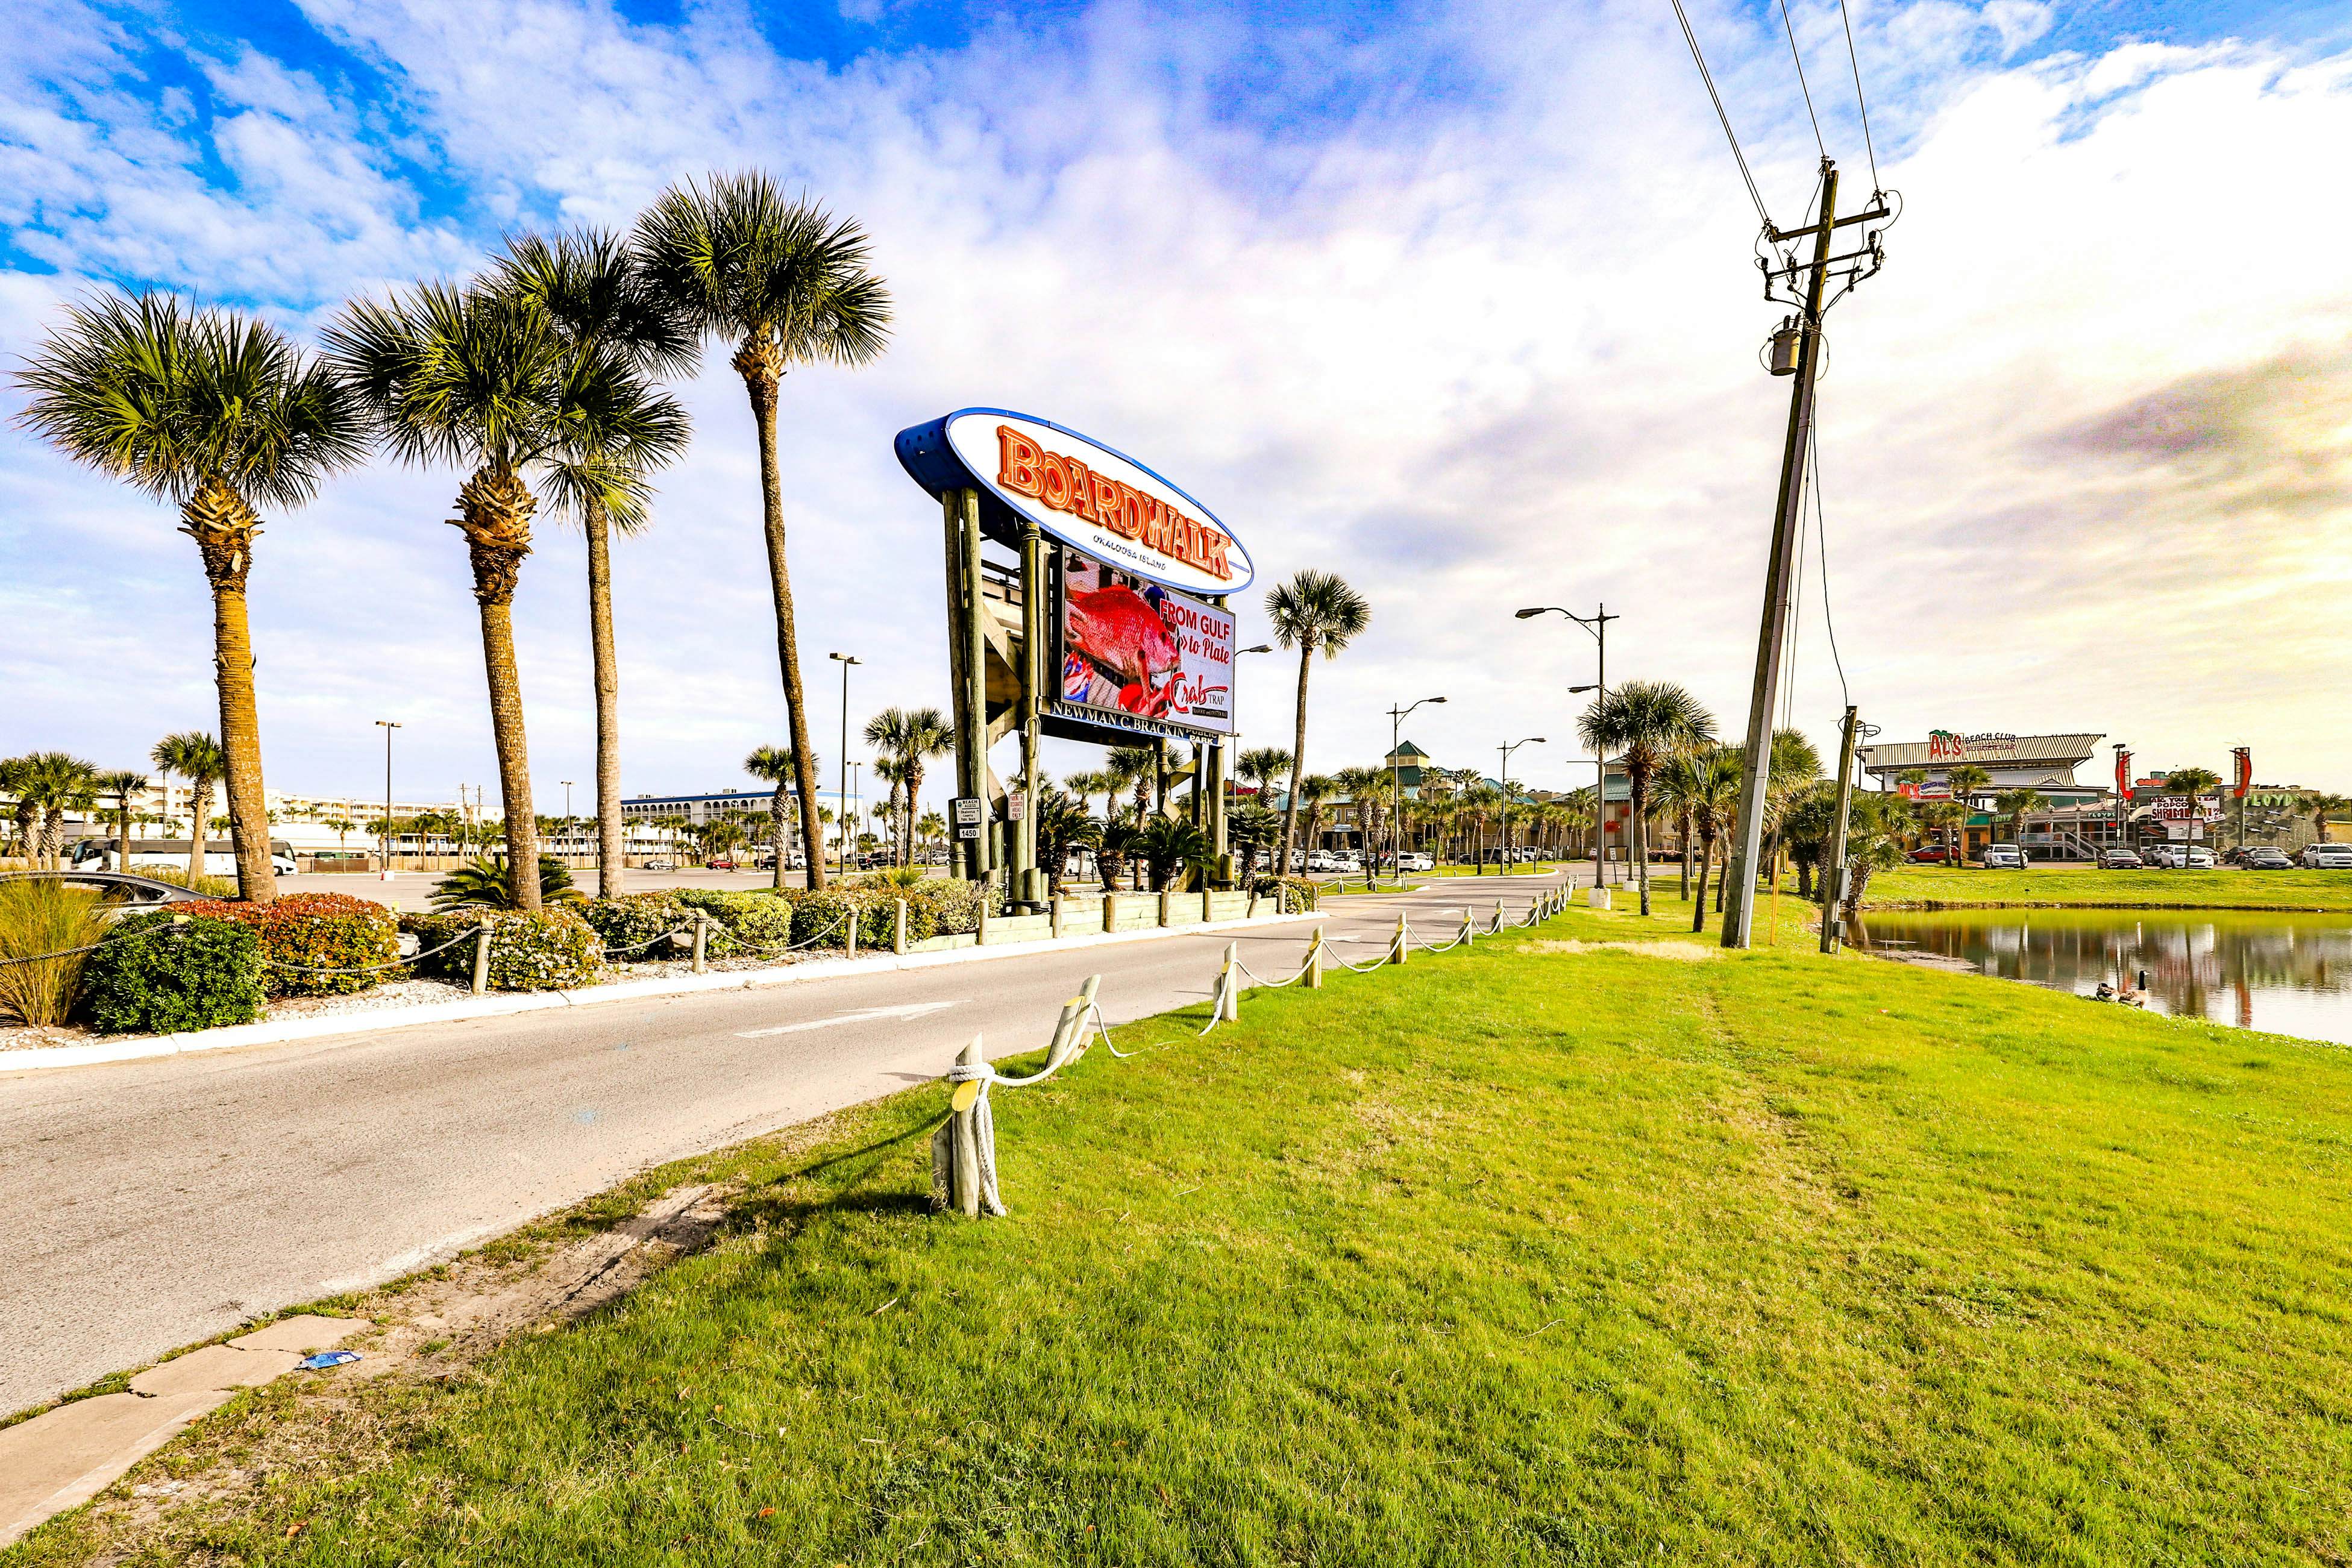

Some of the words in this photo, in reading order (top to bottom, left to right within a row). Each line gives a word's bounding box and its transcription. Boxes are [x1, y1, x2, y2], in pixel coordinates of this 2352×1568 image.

[997, 425, 1232, 580] BOARDWALK
[1093, 535, 1137, 559] OKALOOSA
[1139, 554, 1166, 570] ISLAND
[1160, 598, 1197, 630] FROM
[1200, 614, 1230, 641] GULF
[1189, 635, 1200, 654] to
[1202, 638, 1229, 665] Plate
[1171, 672, 1228, 713] Crab
[1208, 694, 1225, 705] TRAP
[1053, 701, 1117, 726] NEWMAN
[1120, 716, 1131, 729] C.
[1133, 718, 1184, 738] BRACKIN
[1189, 735, 1214, 745] PARK
[1965, 733, 1992, 744] BEACH
[1995, 733, 2016, 742] CLUB
